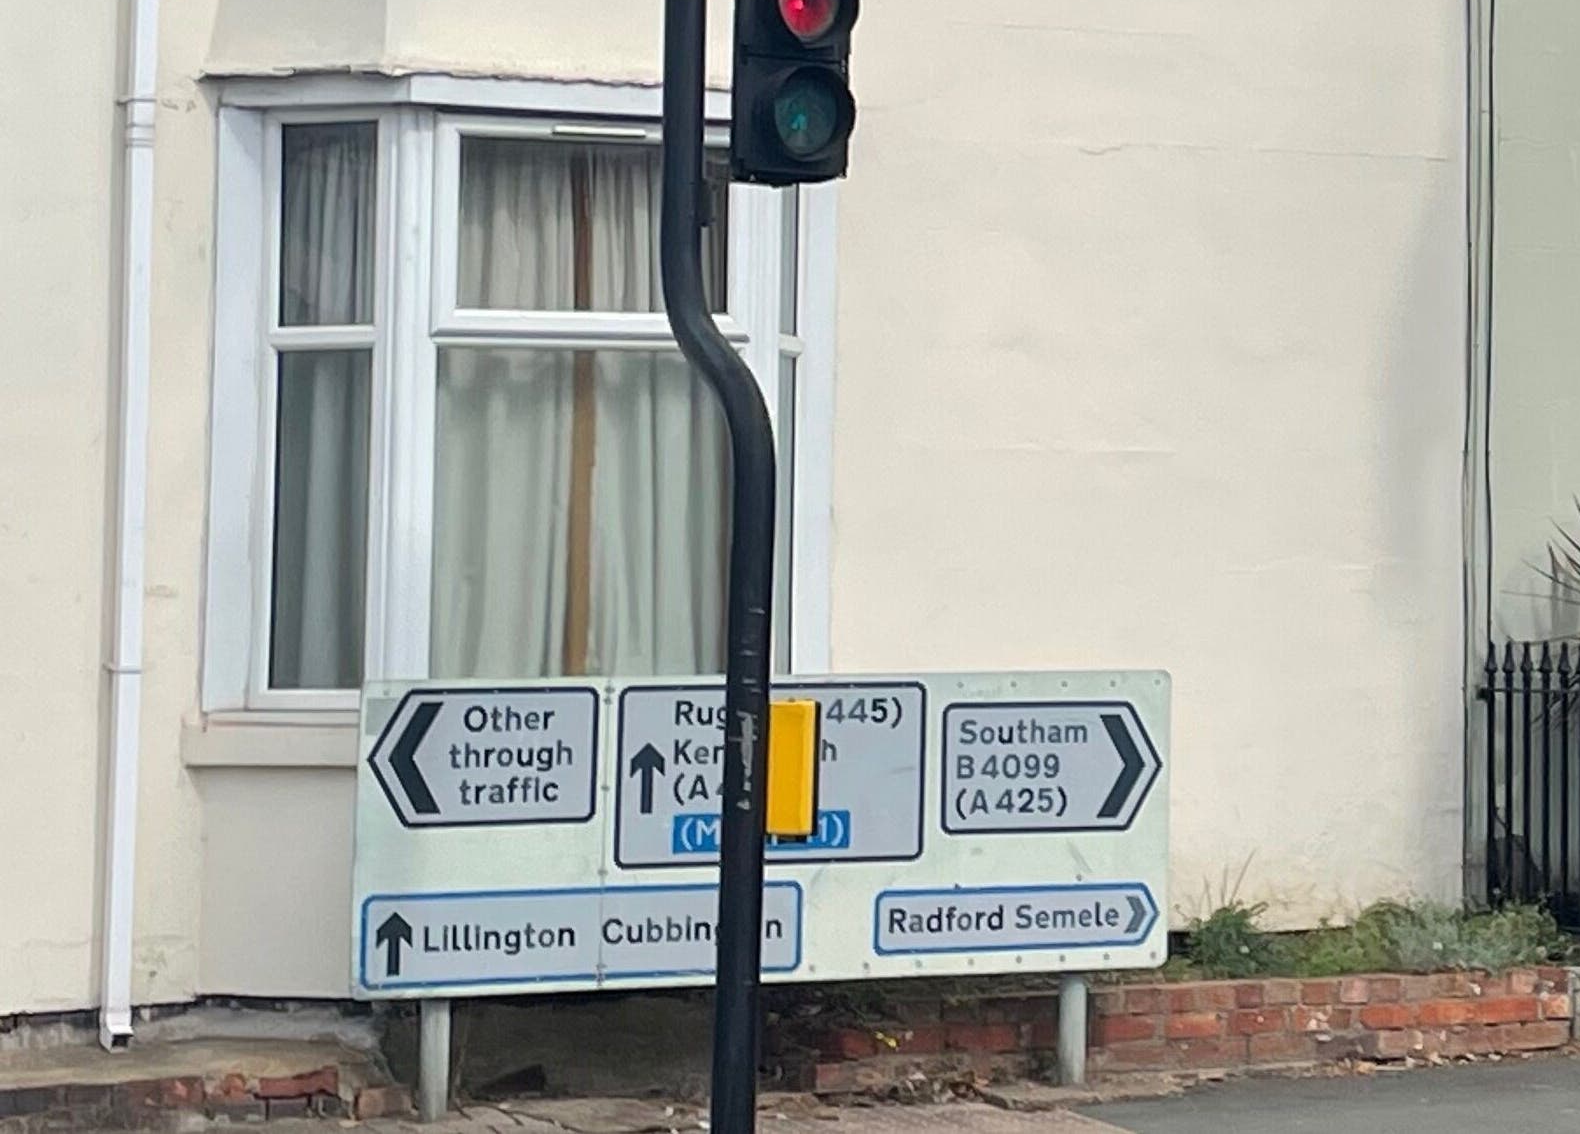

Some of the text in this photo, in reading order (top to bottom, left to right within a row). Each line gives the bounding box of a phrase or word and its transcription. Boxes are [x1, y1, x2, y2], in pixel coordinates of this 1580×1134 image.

[463, 705, 555, 733] Other
[959, 719, 1088, 744] Southam
[448, 739, 573, 771] through
[459, 776, 559, 805] traffic
[601, 916, 783, 947] Cubbinn
[887, 902, 1119, 933] Radford Semele
[423, 923, 576, 954] Lillington
